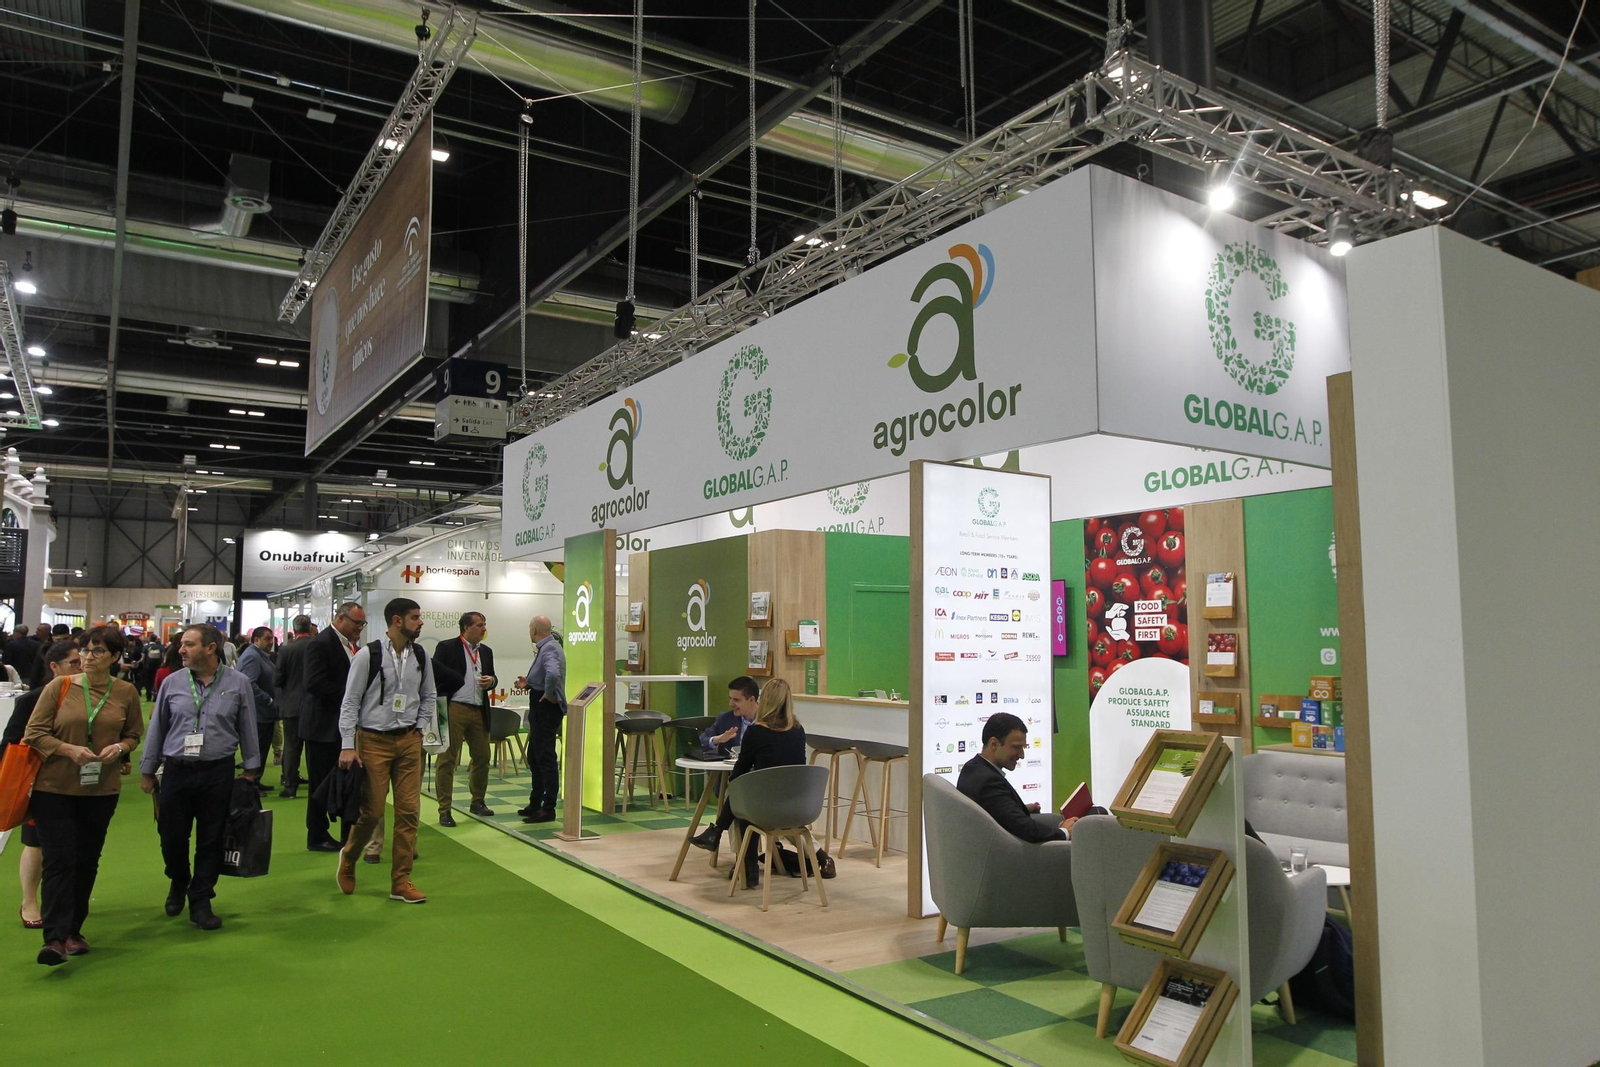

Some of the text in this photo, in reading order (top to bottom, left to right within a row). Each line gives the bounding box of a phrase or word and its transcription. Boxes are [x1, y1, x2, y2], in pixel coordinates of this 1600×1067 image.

[351, 238, 382, 292] Ese gusto
[345, 278, 386, 345] que nos hace
[444, 368, 450, 393] 9
[485, 370, 501, 394] 9
[873, 383, 1021, 457] agrocolor
[1184, 394, 1323, 447] GLOBALG.A.P.
[704, 460, 788, 500] GLOBALG.A.P.
[591, 487, 650, 528] agrocolor
[447, 540, 499, 550] CULTIVOS
[426, 565, 480, 577] hortiespaña
[935, 608, 947, 616] ICA
[1136, 602, 1159, 611] FOOD
[1138, 616, 1164, 625] SAFETY
[569, 628, 597, 646] agrocolor
[677, 632, 716, 652] agrocolor
[1138, 630, 1158, 639] FIRST
[1119, 688, 1170, 697] GLOBALG.A.P.
[1108, 697, 1170, 707] PRODUCE SAFETY
[1126, 709, 1170, 718] ASSURANCE
[1131, 719, 1170, 728] STANDARD
